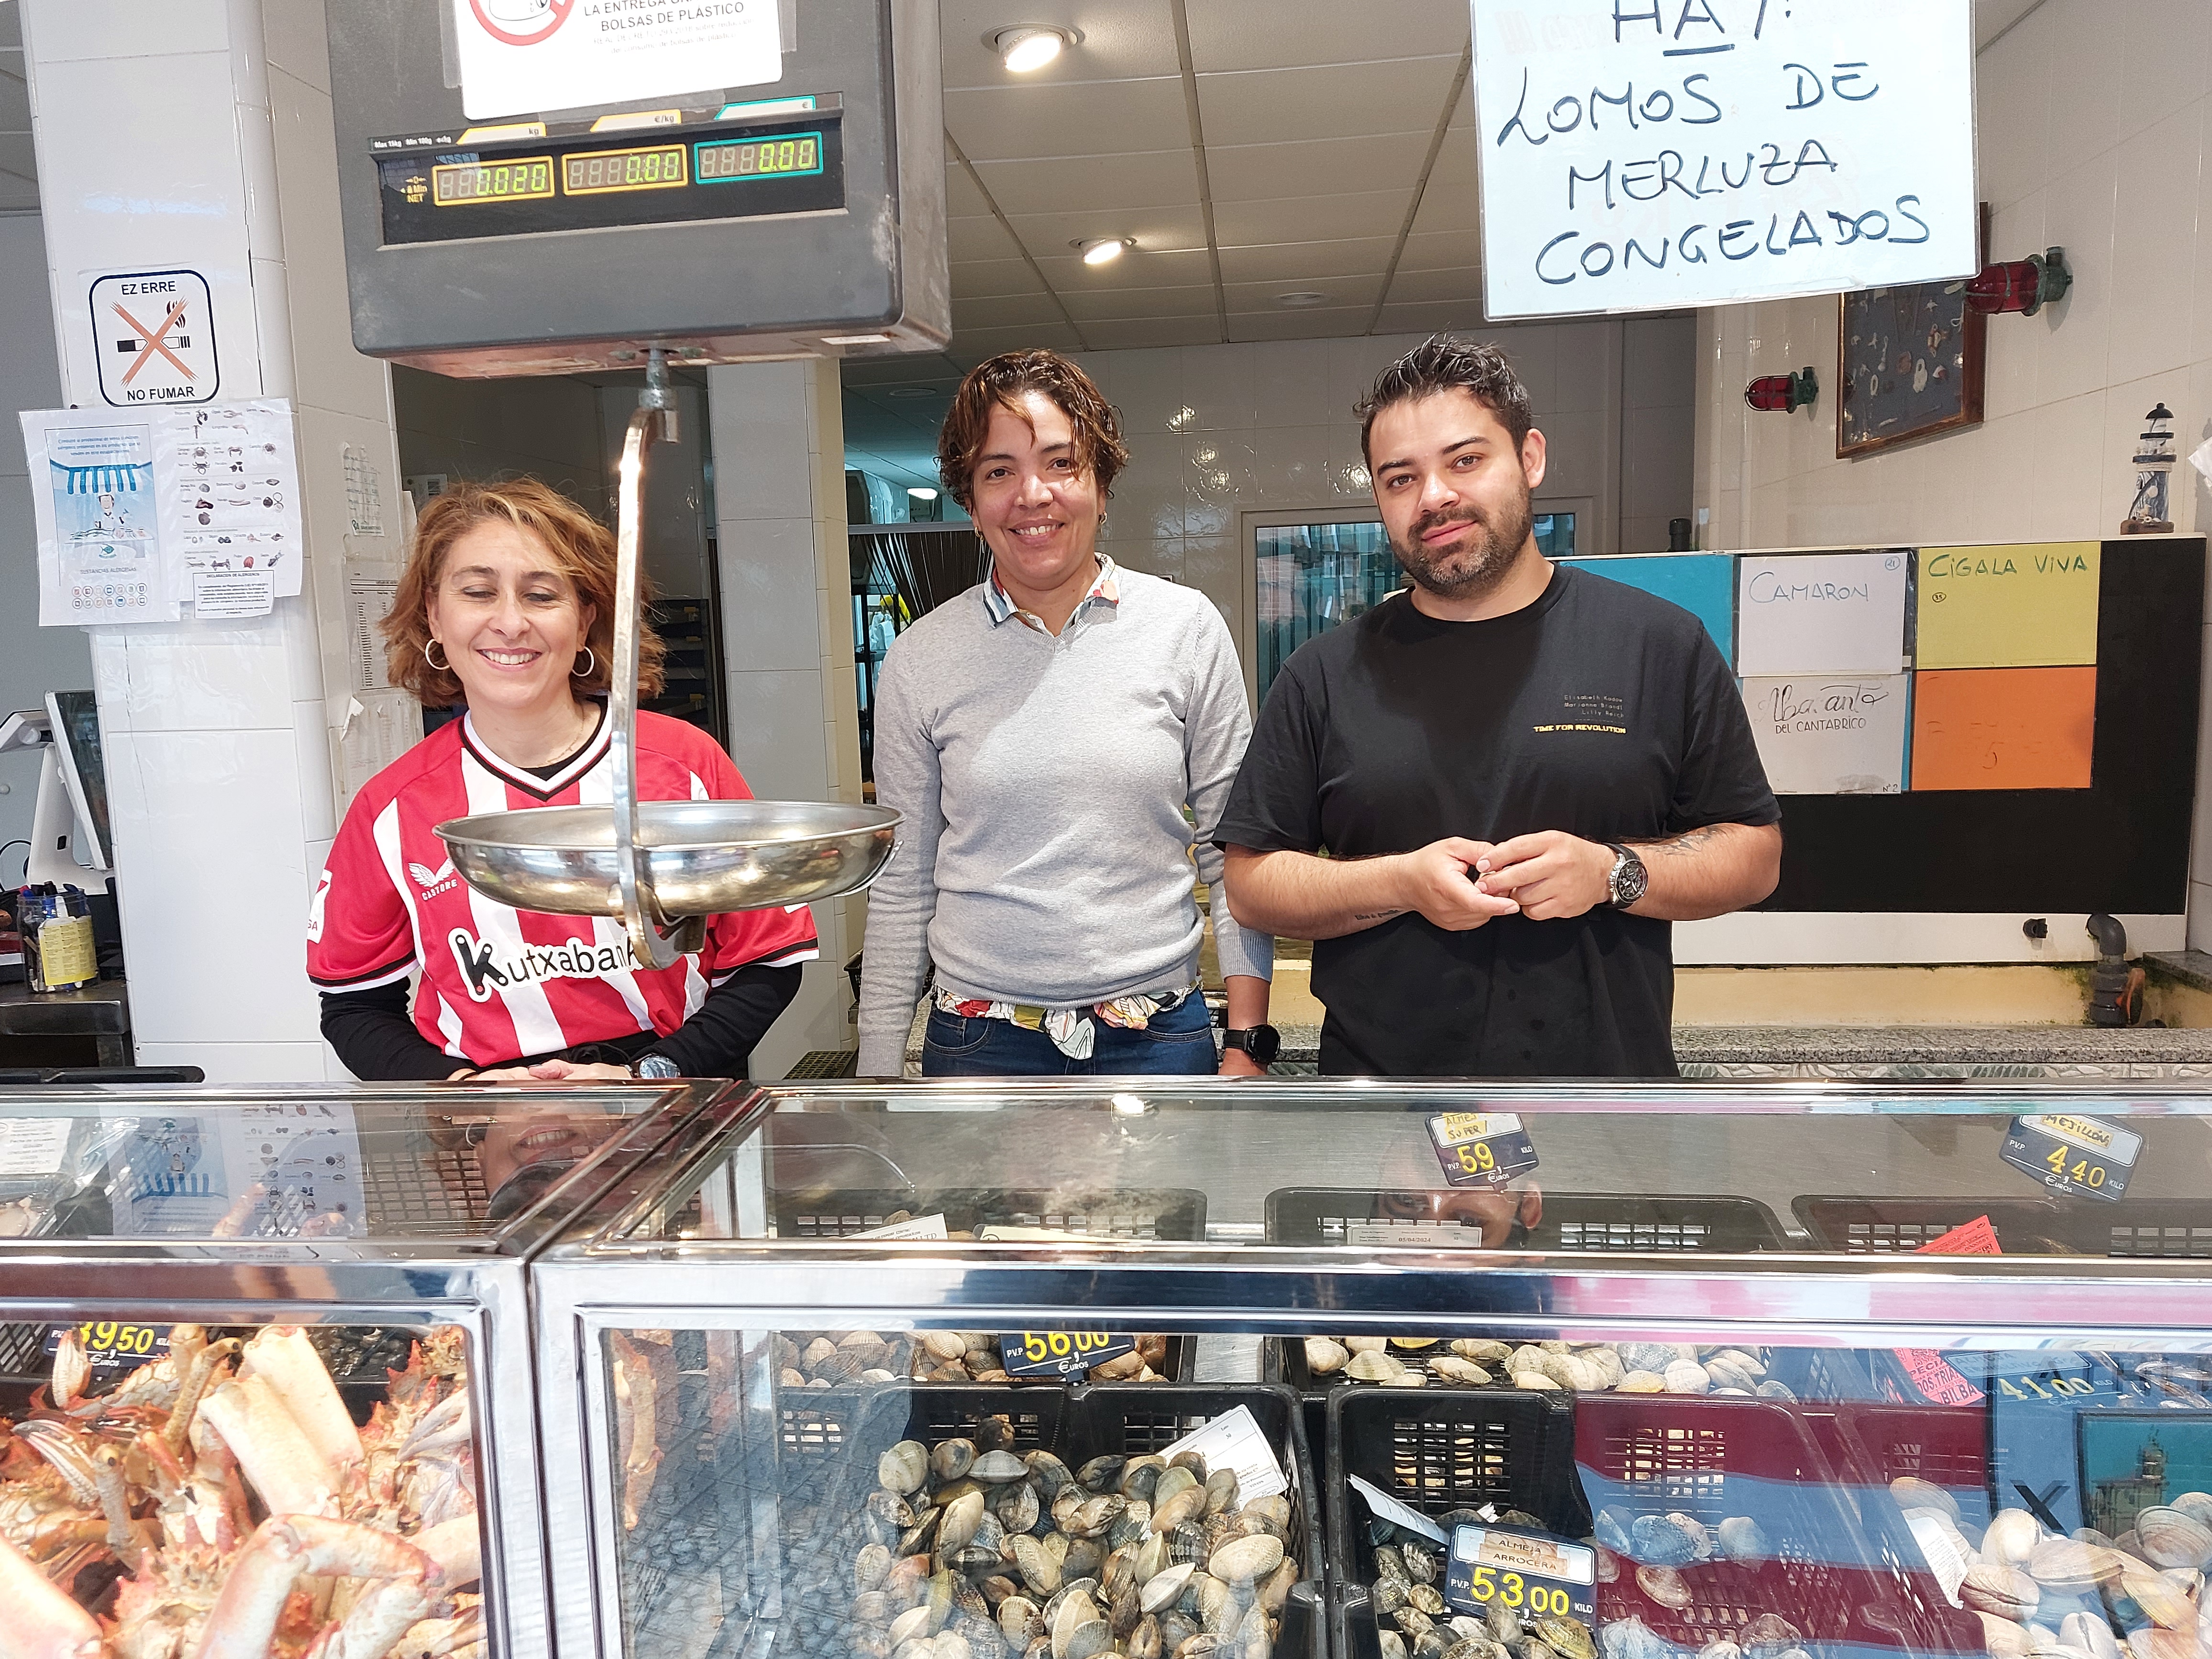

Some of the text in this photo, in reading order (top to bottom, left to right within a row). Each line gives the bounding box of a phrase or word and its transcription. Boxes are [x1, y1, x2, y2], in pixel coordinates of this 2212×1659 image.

[584, 4, 600, 16] LA
[601, 14, 653, 32] BOLSAS
[657, 11, 674, 23] DE
[1497, 61, 1880, 147] LOMOS DE
[654, 114, 675, 125] €/kg
[528, 127, 540, 135] kg
[1568, 138, 1838, 210] MERLUZA
[407, 194, 424, 203] NET
[1535, 194, 1931, 286] CONGELADOS
[121, 280, 177, 295] EZ ERRE
[127, 386, 196, 401] NO FUMAR
[1749, 571, 1869, 603] CAMARON
[1575, 724, 1626, 734] REVOLUTION
[1892, 784, 1899, 793] 2
[421, 878, 458, 901] CASTORE
[1520, 1145, 1533, 1154] KILO
[2108, 1179, 2125, 1190] KILO
[1498, 1540, 1541, 1554] ALMEJA
[1493, 1553, 1557, 1570] ARROCERA
[1574, 1602, 1593, 1614] KILO
